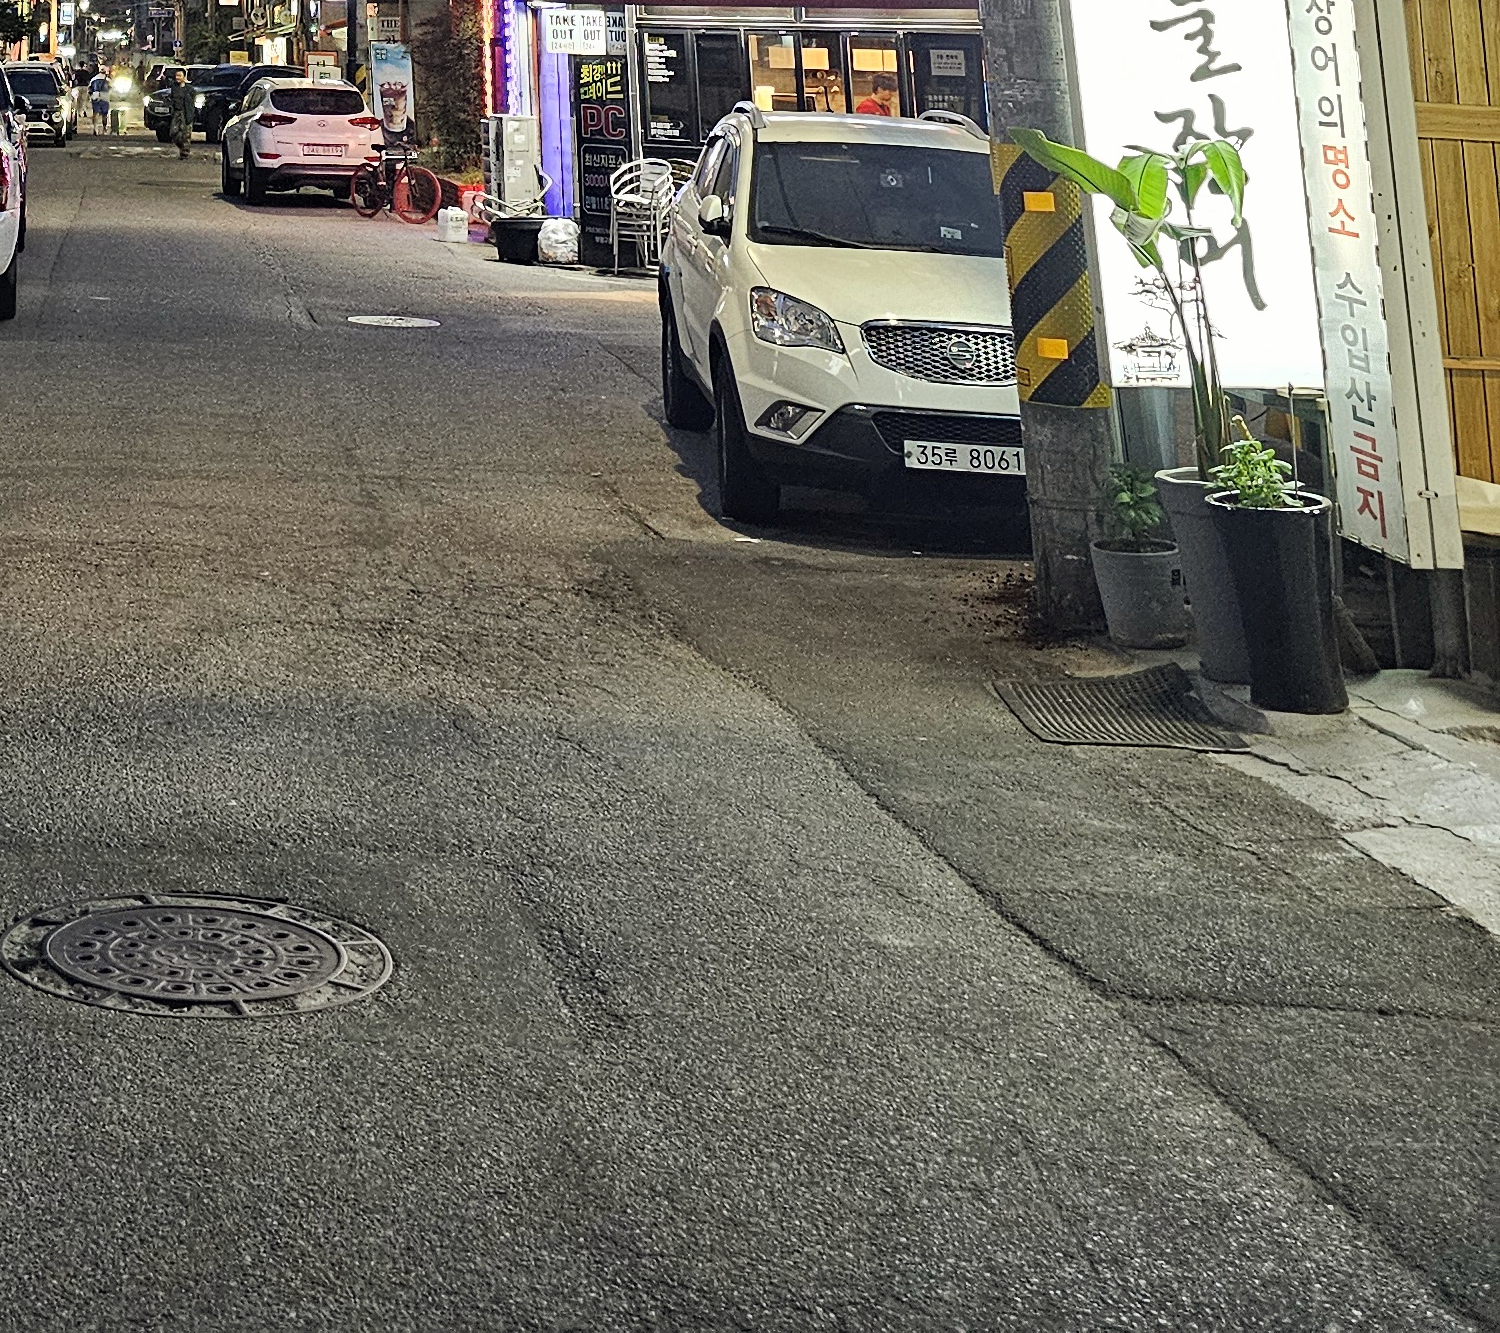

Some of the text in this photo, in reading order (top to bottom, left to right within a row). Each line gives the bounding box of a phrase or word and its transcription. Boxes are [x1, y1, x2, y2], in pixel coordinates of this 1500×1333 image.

[549, 15, 576, 27] TAKE
[581, 15, 603, 27] TAKE
[552, 29, 574, 41] OUT
[583, 29, 601, 41] OUT
[581, 104, 625, 139] PC
[916, 445, 1021, 471] 35루 8061
